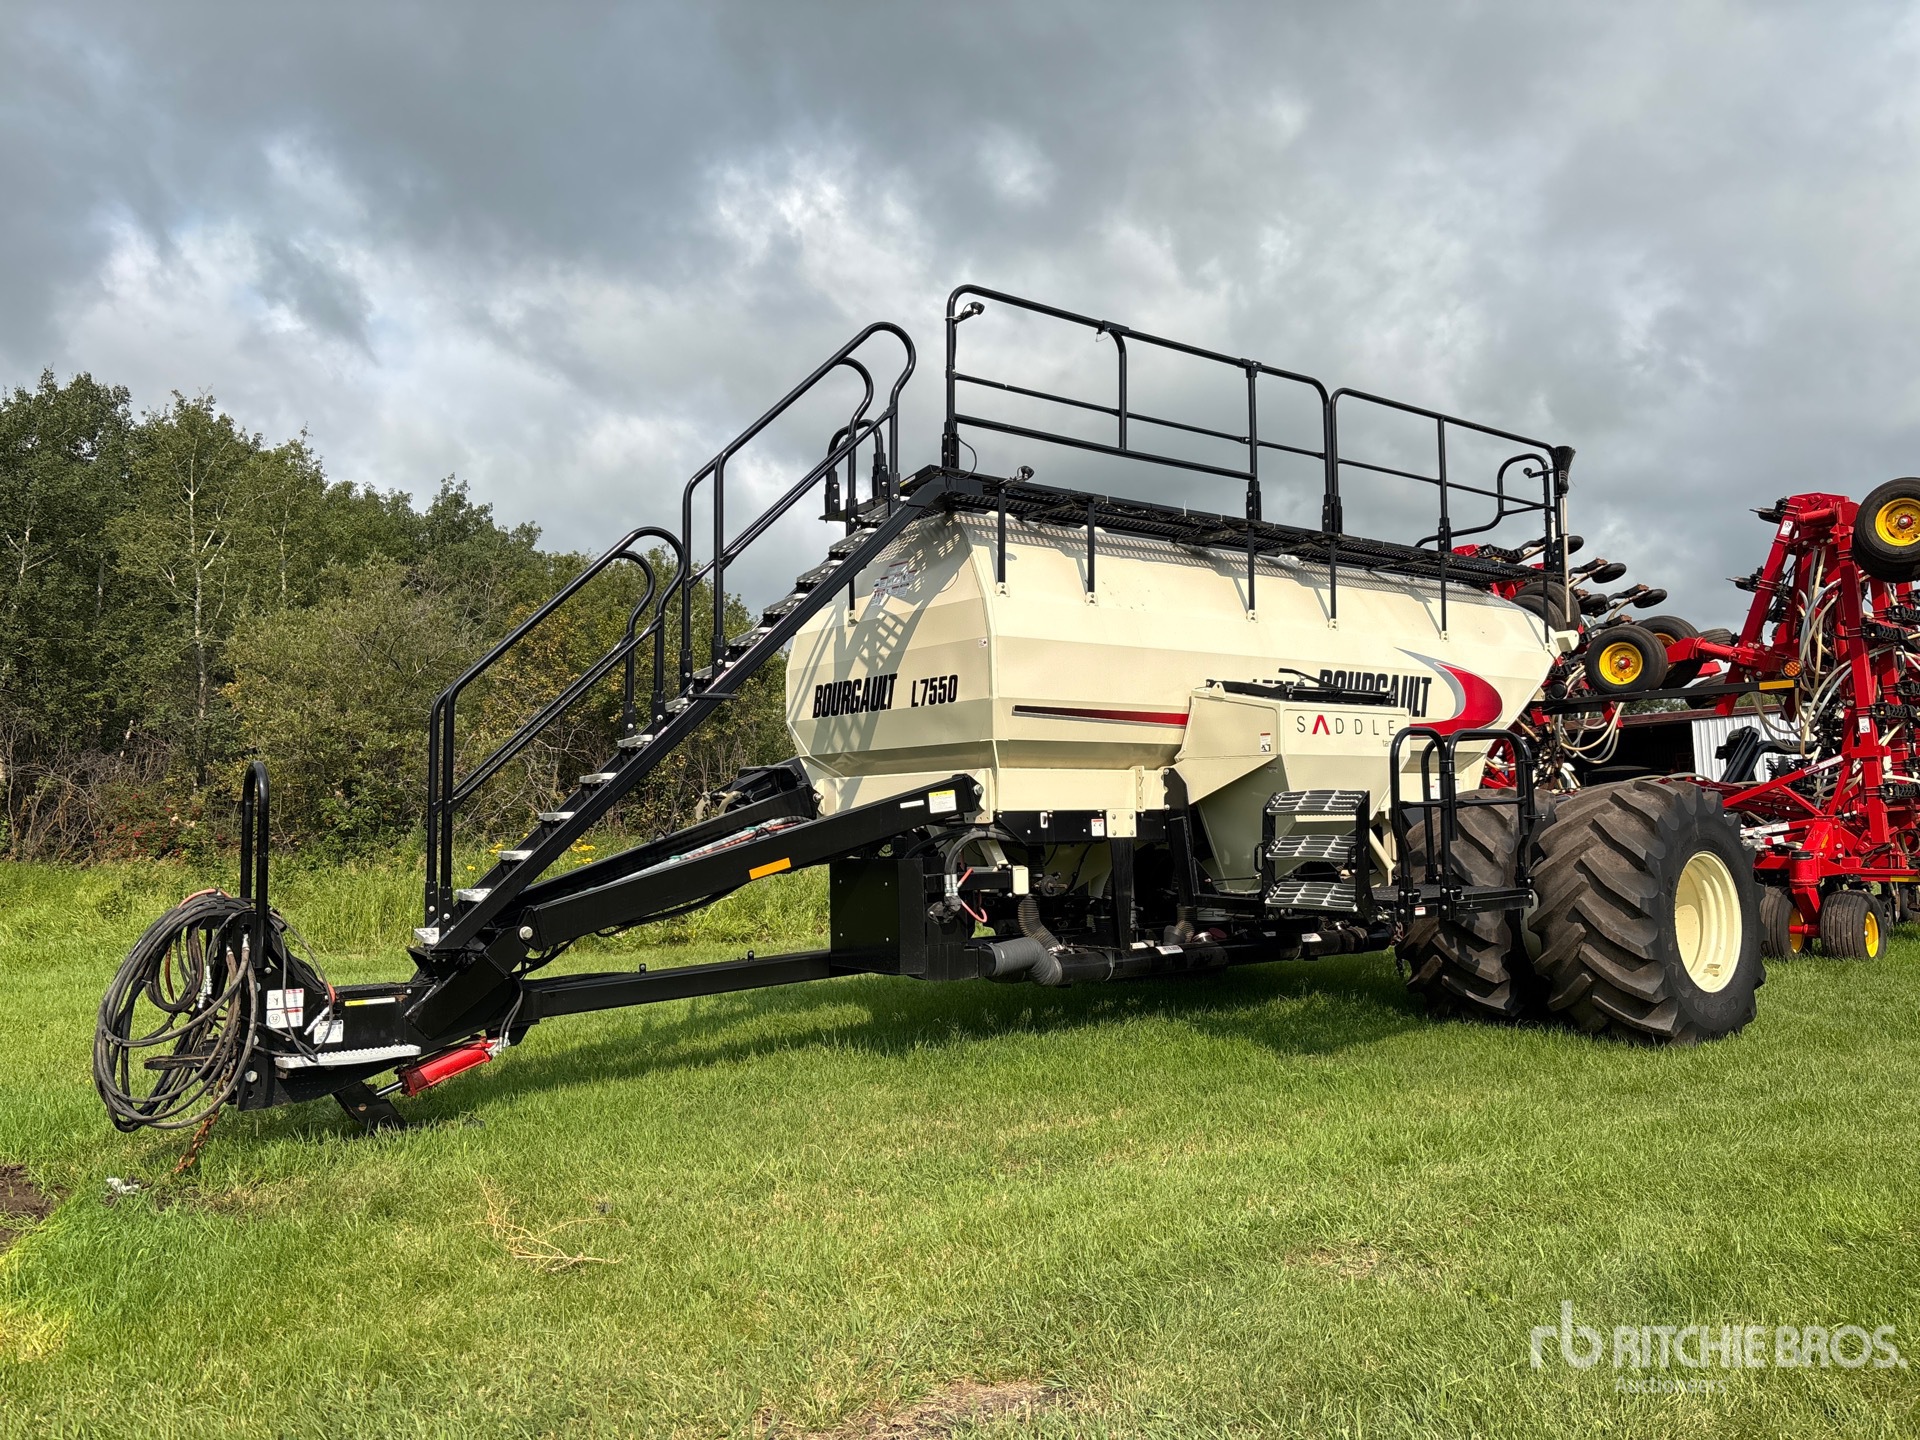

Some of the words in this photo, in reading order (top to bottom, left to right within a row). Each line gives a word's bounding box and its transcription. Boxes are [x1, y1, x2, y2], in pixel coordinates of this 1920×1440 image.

[812, 673, 898, 718] BOURGAULT
[911, 674, 959, 708] L7550
[1296, 714, 1396, 736] SADDLE
